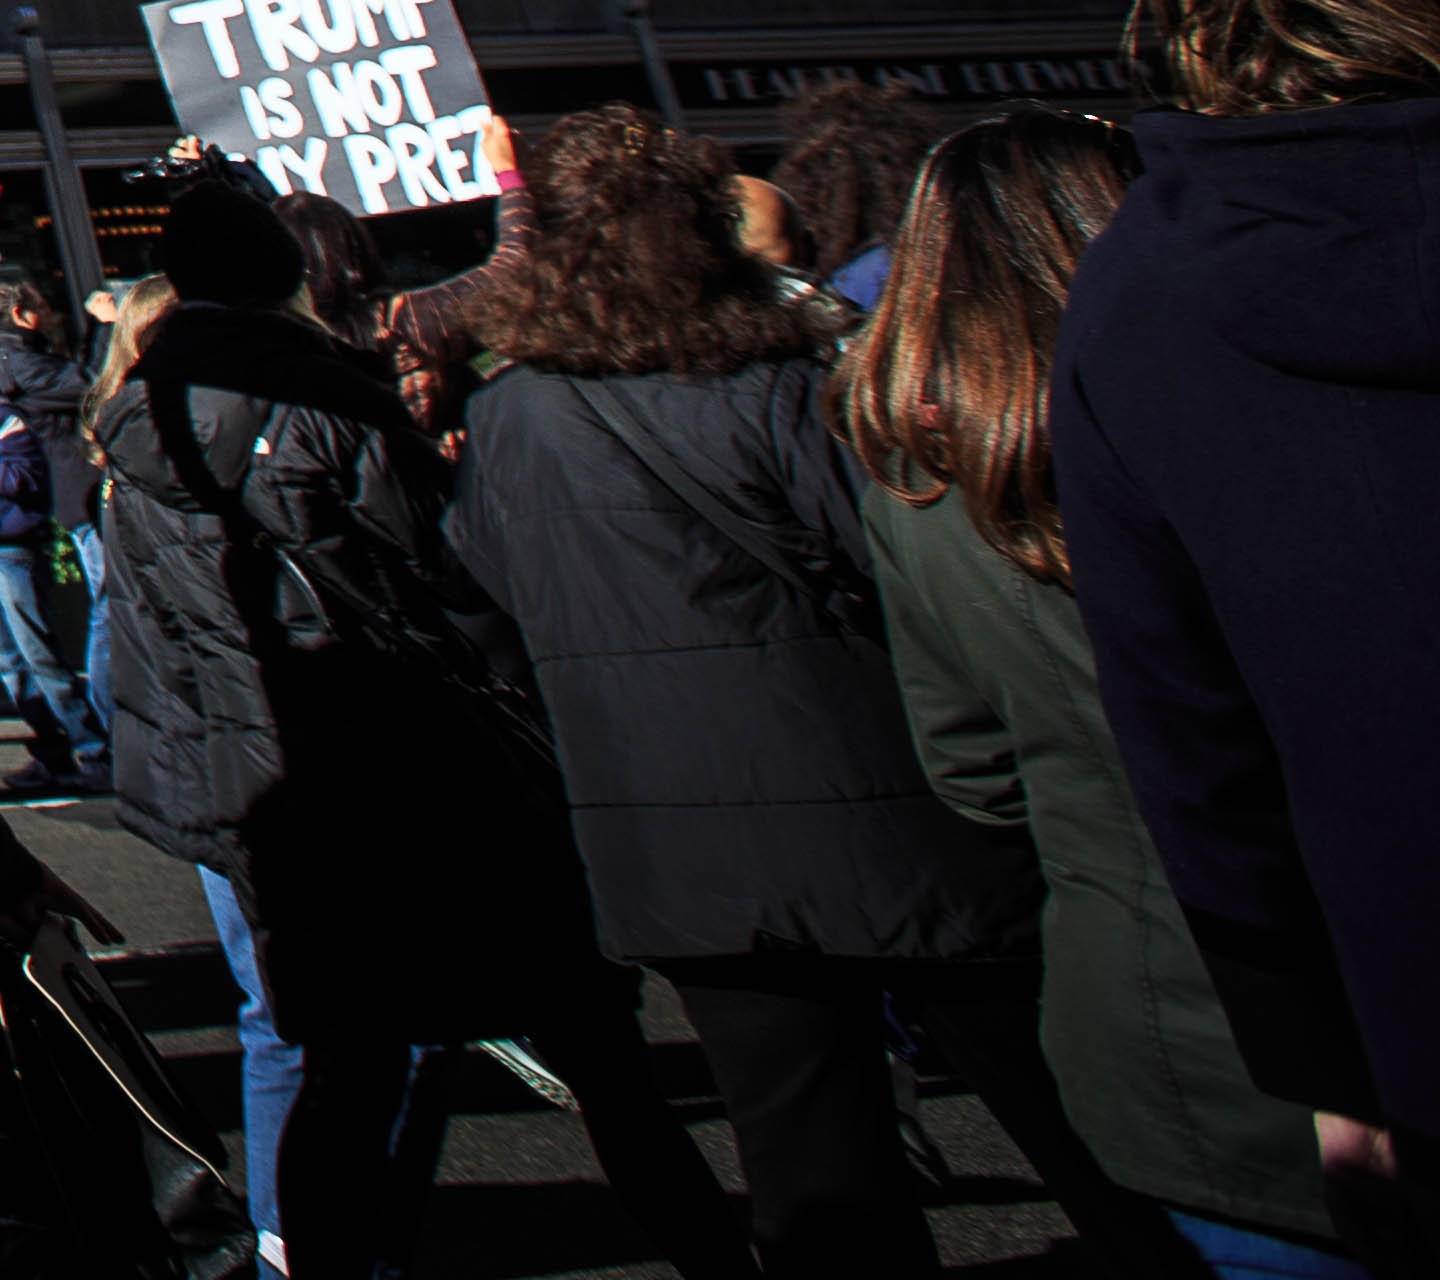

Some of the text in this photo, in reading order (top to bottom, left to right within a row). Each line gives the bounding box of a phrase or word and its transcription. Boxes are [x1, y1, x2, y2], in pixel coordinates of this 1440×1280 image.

[239, 44, 437, 140] IS NOT
[342, 104, 502, 215] PREZ
